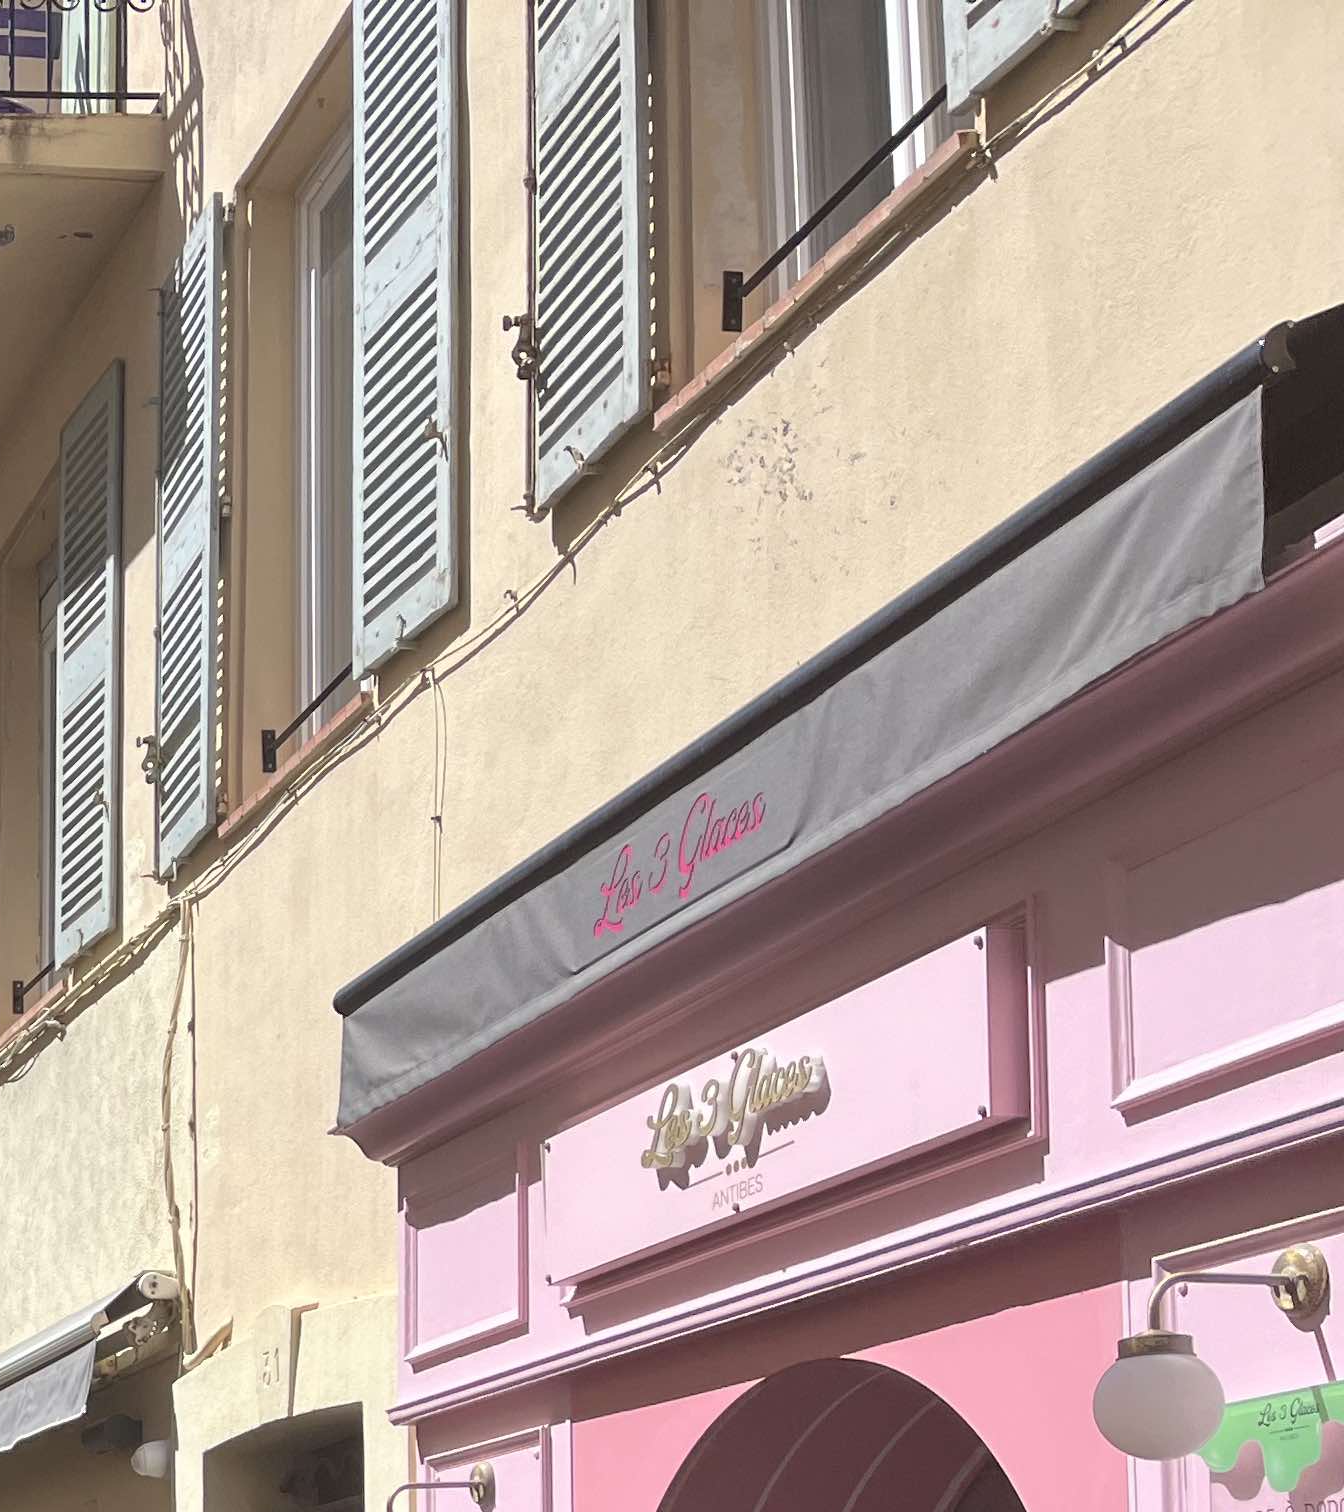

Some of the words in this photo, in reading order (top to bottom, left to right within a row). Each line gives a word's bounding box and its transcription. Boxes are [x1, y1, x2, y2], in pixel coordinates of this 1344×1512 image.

[649, 832, 672, 893] 3
[678, 791, 766, 900] Glaces
[698, 1078, 720, 1136] 3
[728, 1048, 817, 1146] Glaces
[712, 1173, 764, 1211] ANTIBES
[1279, 1404, 1288, 1420] 3
